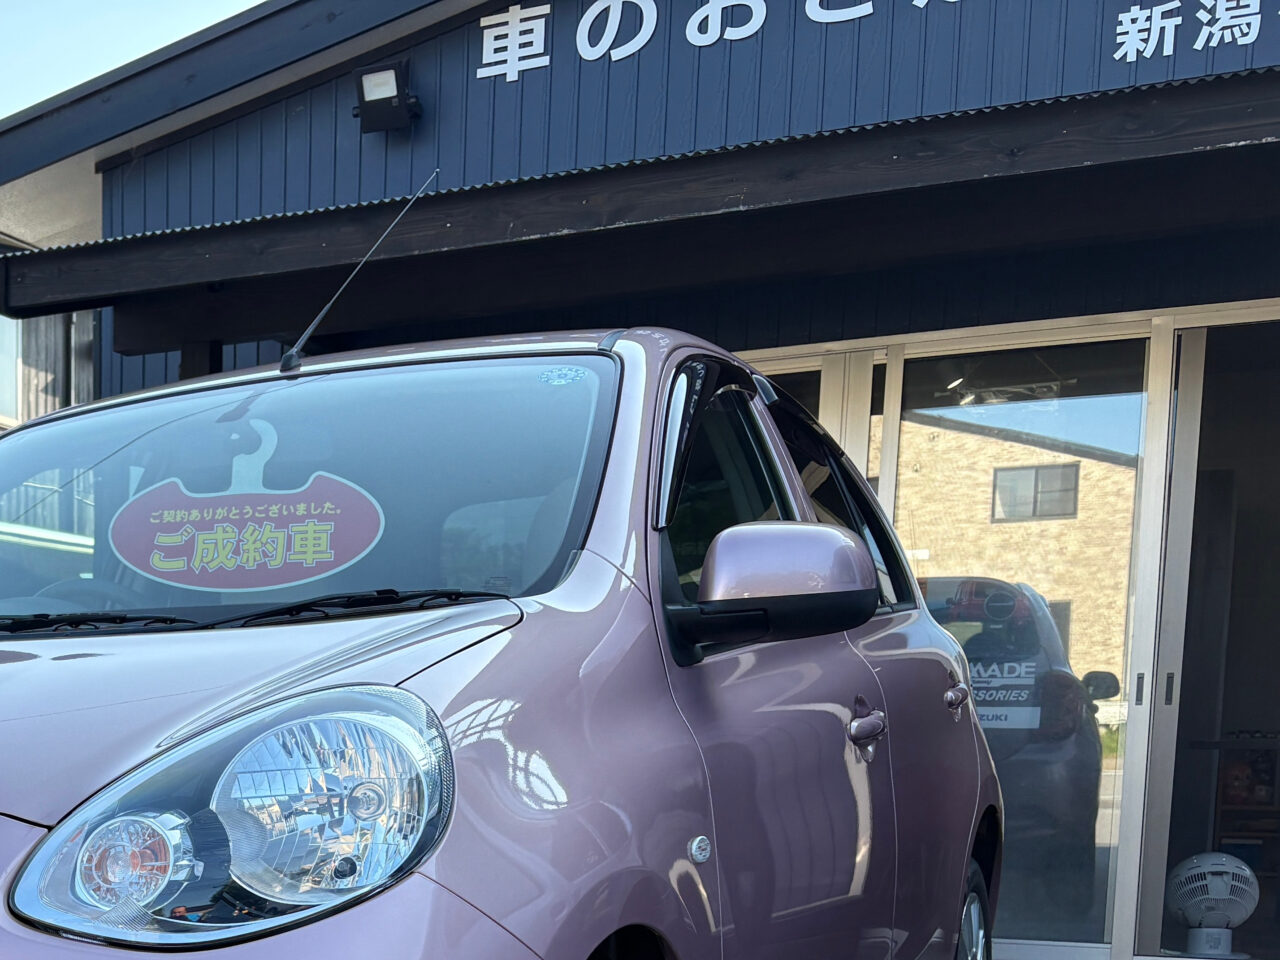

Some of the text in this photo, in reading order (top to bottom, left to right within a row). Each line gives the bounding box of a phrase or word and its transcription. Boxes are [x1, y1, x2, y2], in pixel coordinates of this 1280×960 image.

[150, 502, 342, 524] ご契約ありがとうございました。
[150, 519, 334, 574] ご成約車
